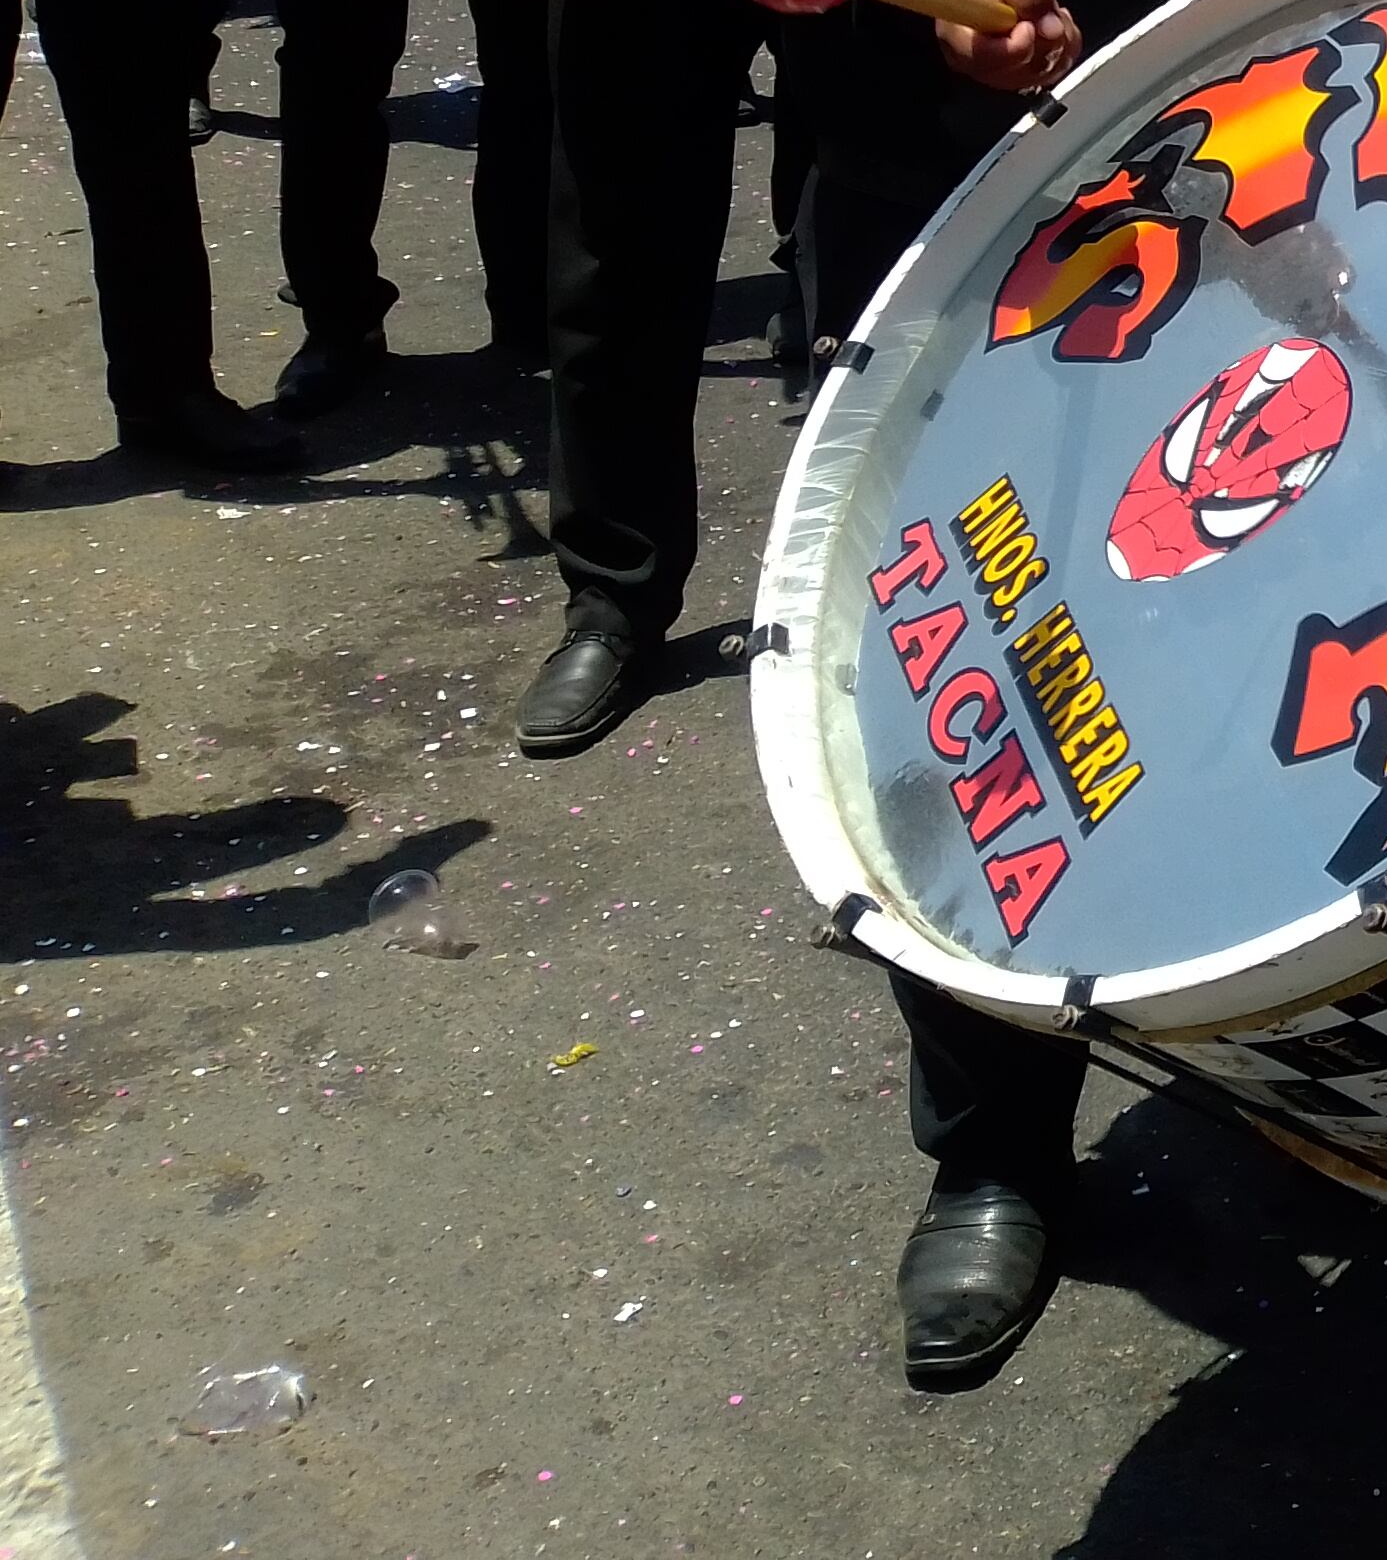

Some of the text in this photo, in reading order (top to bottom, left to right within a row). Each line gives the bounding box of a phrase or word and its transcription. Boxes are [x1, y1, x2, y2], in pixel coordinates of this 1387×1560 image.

[866, 516, 1075, 950] TACNA
[948, 472, 1147, 840] HNOS. HERRERA
